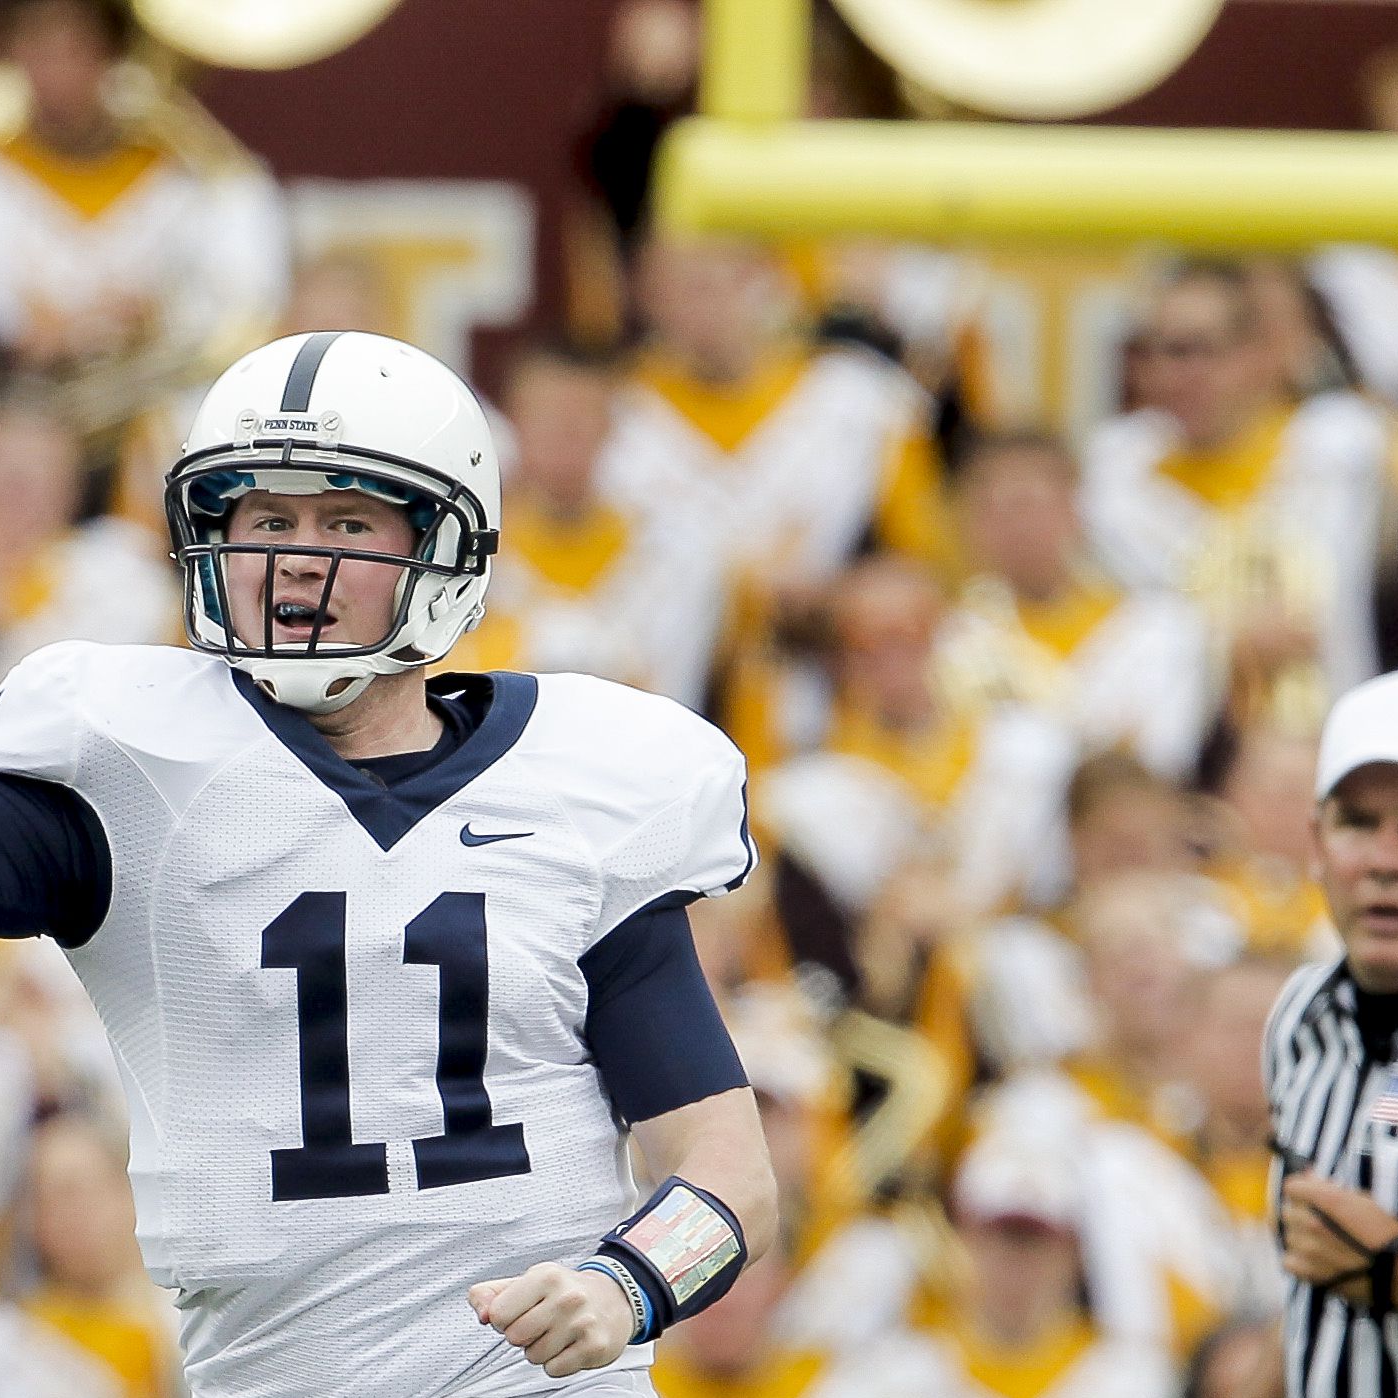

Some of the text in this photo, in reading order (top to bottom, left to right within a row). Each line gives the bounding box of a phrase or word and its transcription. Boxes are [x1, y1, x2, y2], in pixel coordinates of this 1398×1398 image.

[264, 419, 318, 432] PENN STATE
[260, 890, 532, 1202] 11
[610, 1262, 644, 1316] GRATEFUL
